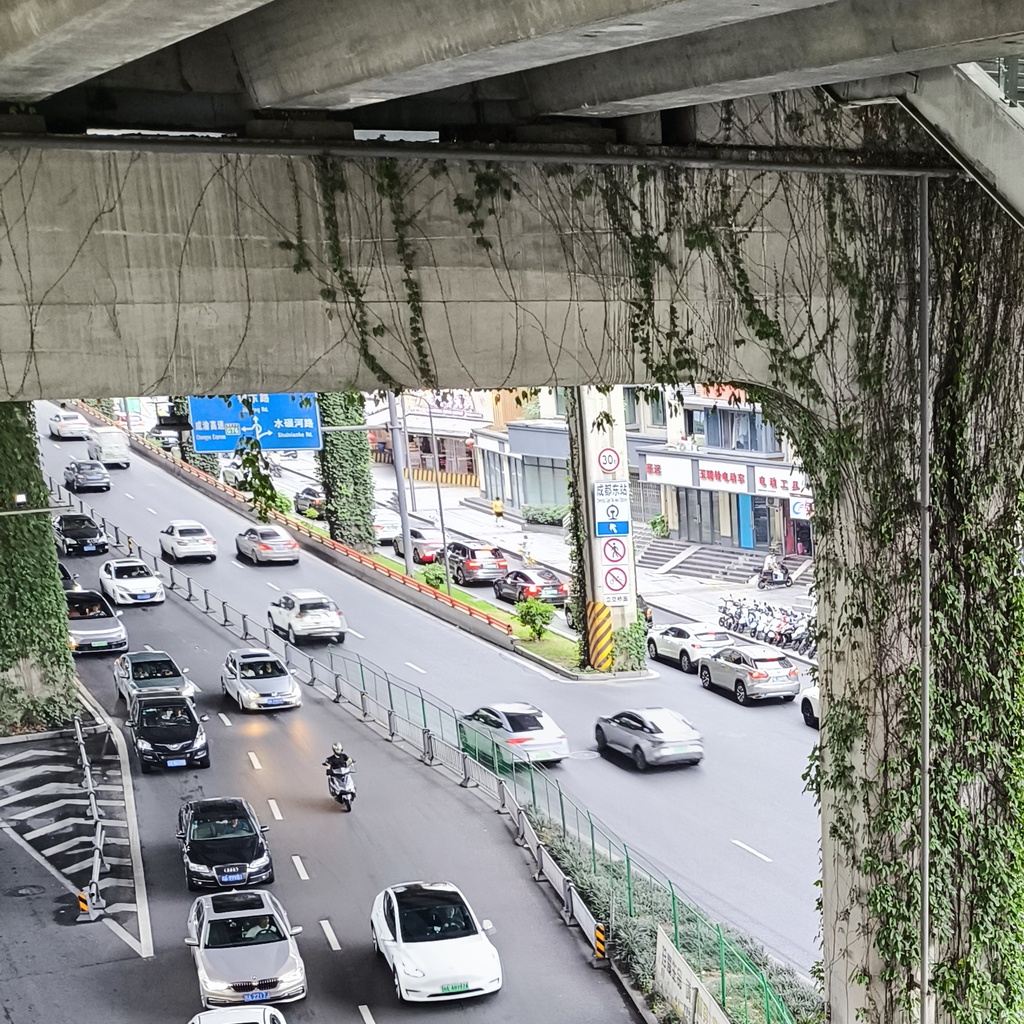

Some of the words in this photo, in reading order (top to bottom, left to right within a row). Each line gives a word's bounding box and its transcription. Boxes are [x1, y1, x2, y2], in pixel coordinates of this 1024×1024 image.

[597, 484, 627, 496] 成都东站
[758, 476, 800, 491] 电动工具
